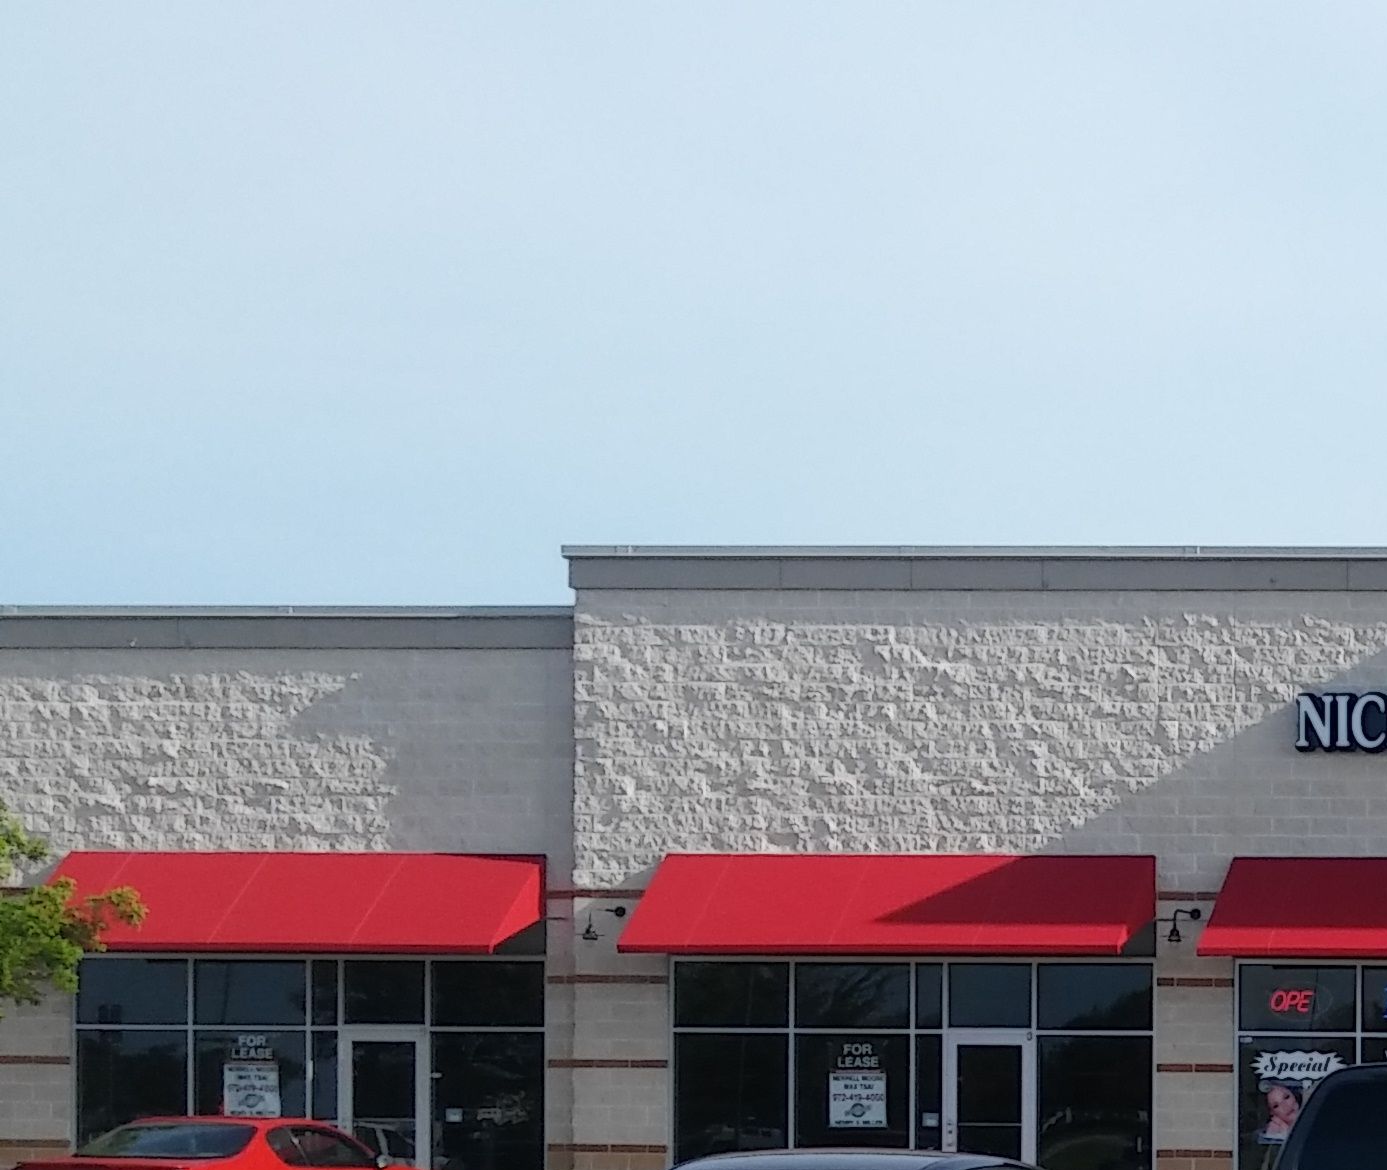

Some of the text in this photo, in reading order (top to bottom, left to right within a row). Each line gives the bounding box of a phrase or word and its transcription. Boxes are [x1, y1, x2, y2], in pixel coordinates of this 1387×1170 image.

[237, 1035, 267, 1047] FOR
[231, 1048, 274, 1059] LEASE
[843, 1043, 873, 1055] FOR
[837, 1056, 880, 1068] LEASE
[1263, 1056, 1331, 1075] Special
